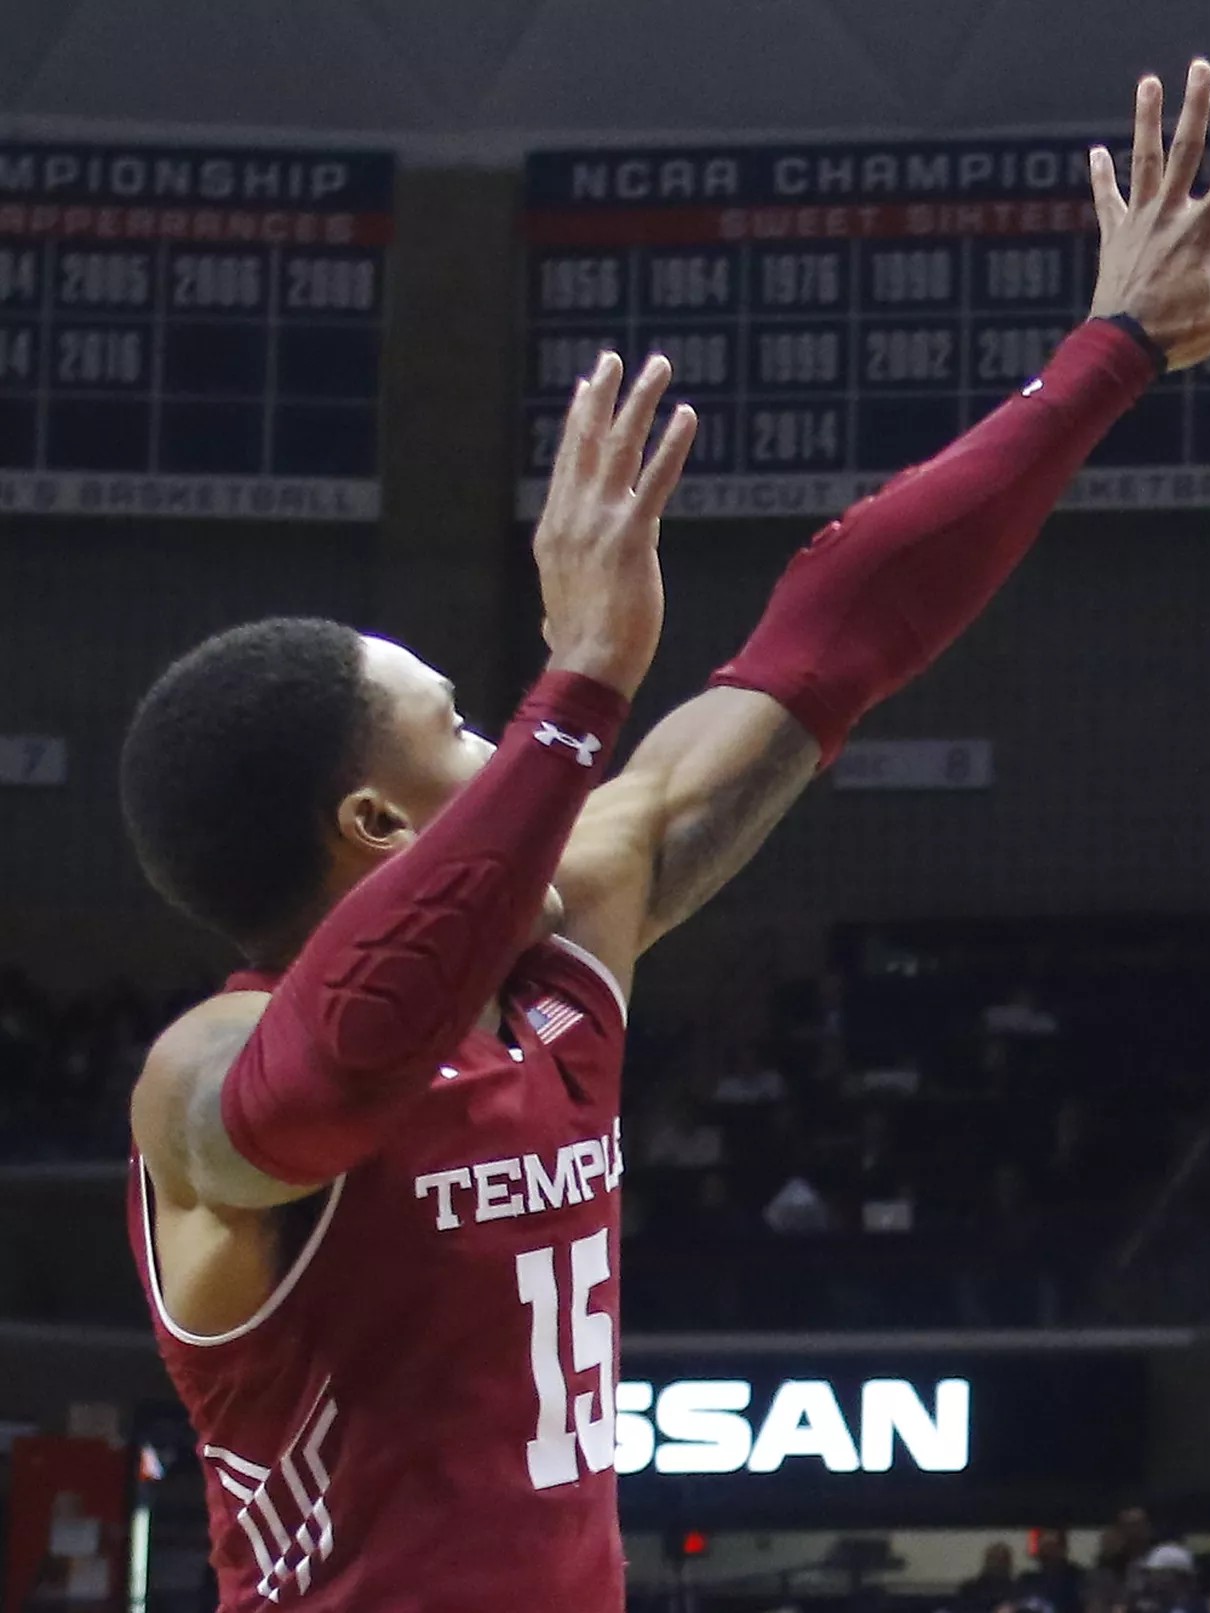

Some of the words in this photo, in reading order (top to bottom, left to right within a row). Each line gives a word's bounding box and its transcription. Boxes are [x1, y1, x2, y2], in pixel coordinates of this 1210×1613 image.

[572, 158, 739, 199] NCAA
[720, 206, 881, 239] SWEET
[516, 1228, 615, 1490] 15
